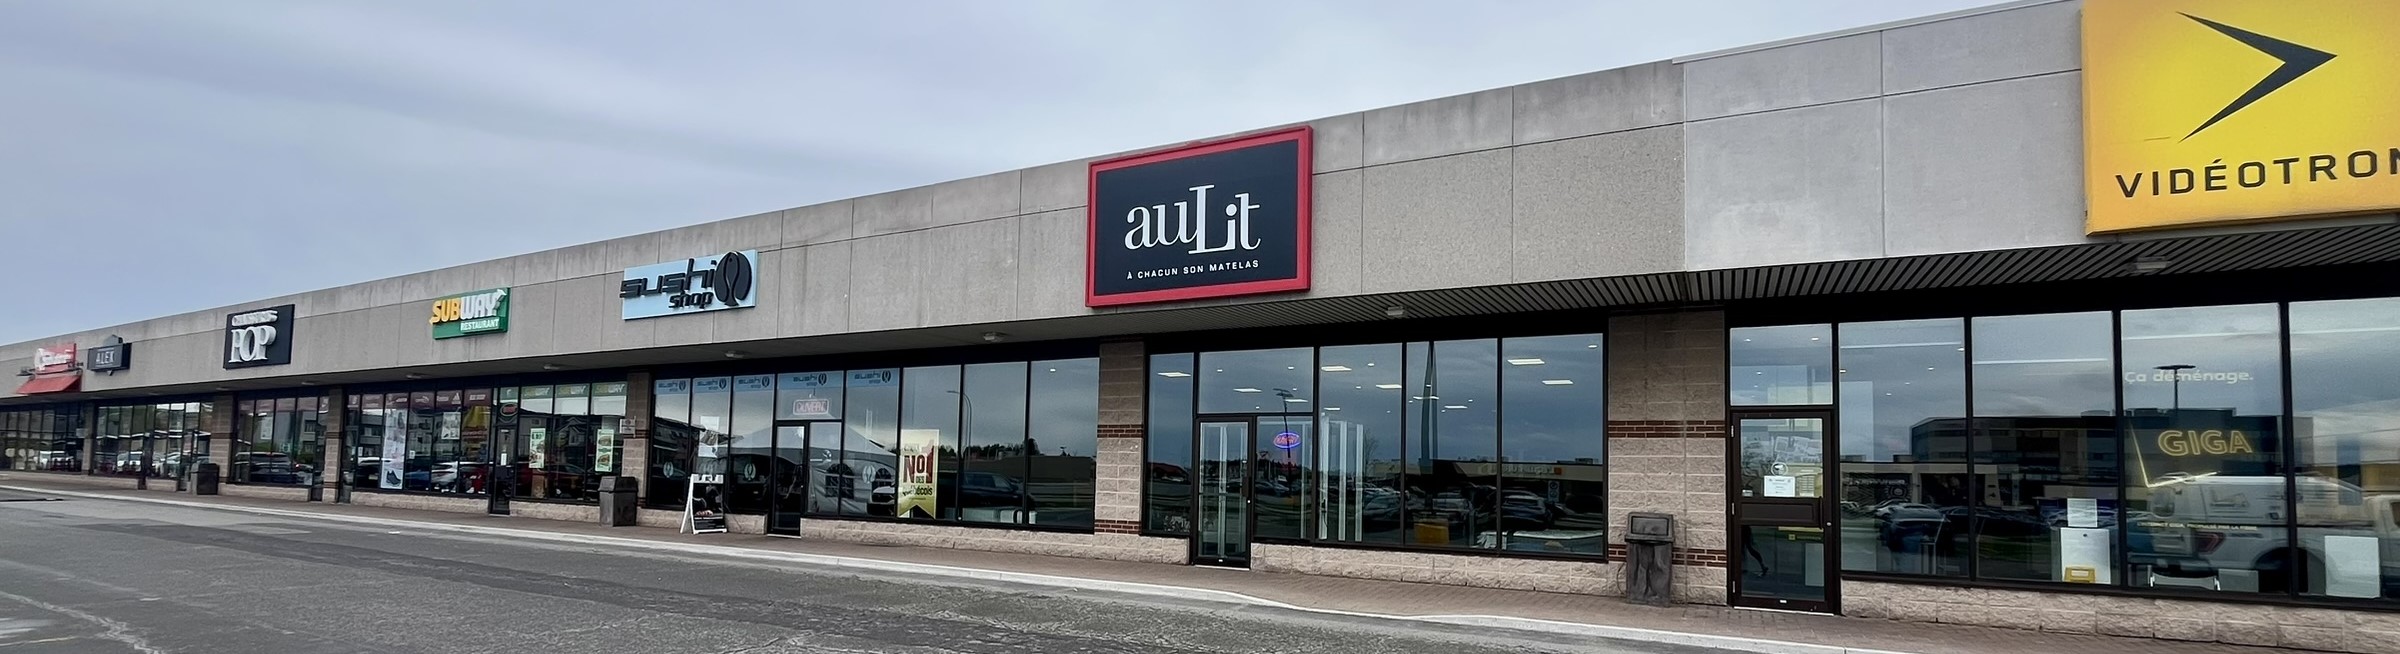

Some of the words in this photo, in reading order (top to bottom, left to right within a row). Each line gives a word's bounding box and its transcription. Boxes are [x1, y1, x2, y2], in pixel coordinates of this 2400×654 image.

[1124, 184, 1262, 255] auLit
[619, 257, 718, 298] sushi
[1137, 267, 1179, 279] CHACUN
[1183, 265, 1204, 276] SON
[1209, 259, 1260, 272] MATELAS
[429, 288, 507, 325] SUBWAY
[668, 289, 714, 310] shop
[460, 317, 500, 331] RESTAURANT
[228, 325, 276, 363] POP
[596, 384, 625, 394] SUBWAY
[2124, 371, 2147, 384] Ça
[2158, 430, 2253, 456] GIGA
